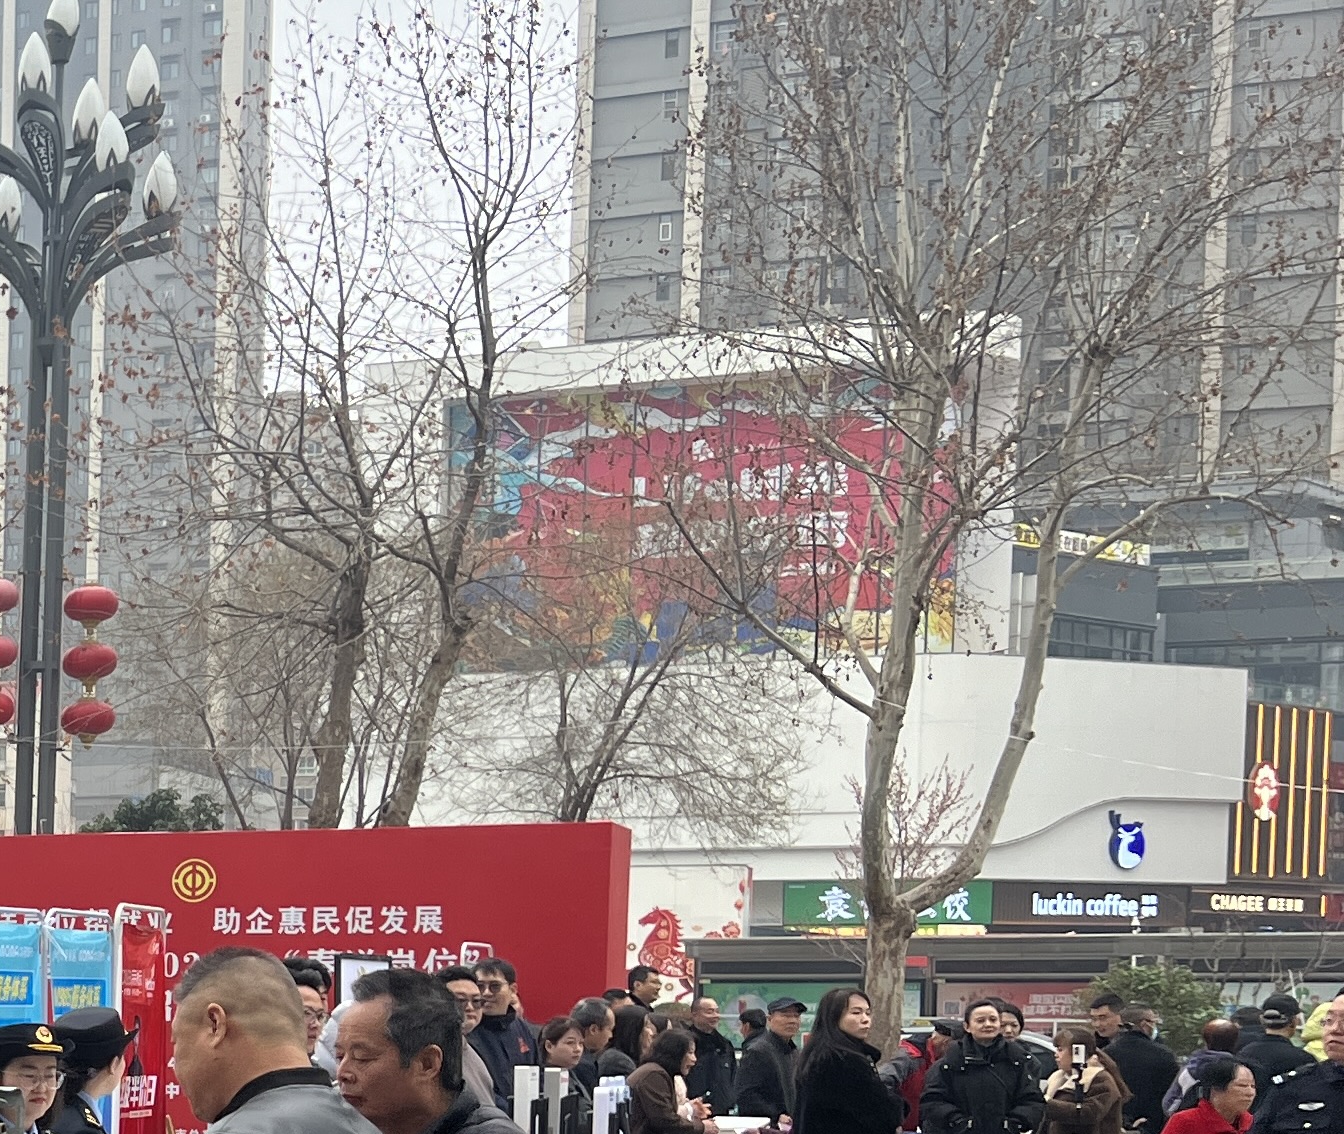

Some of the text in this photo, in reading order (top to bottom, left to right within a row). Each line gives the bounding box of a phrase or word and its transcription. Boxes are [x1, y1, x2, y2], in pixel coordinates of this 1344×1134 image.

[816, 885, 972, 922] 袁饺
[1032, 893, 1082, 916] luckin
[1086, 893, 1139, 917] coffee
[1210, 893, 1264, 912] CHAGEE
[212, 905, 444, 935] 助企惠民促发展
